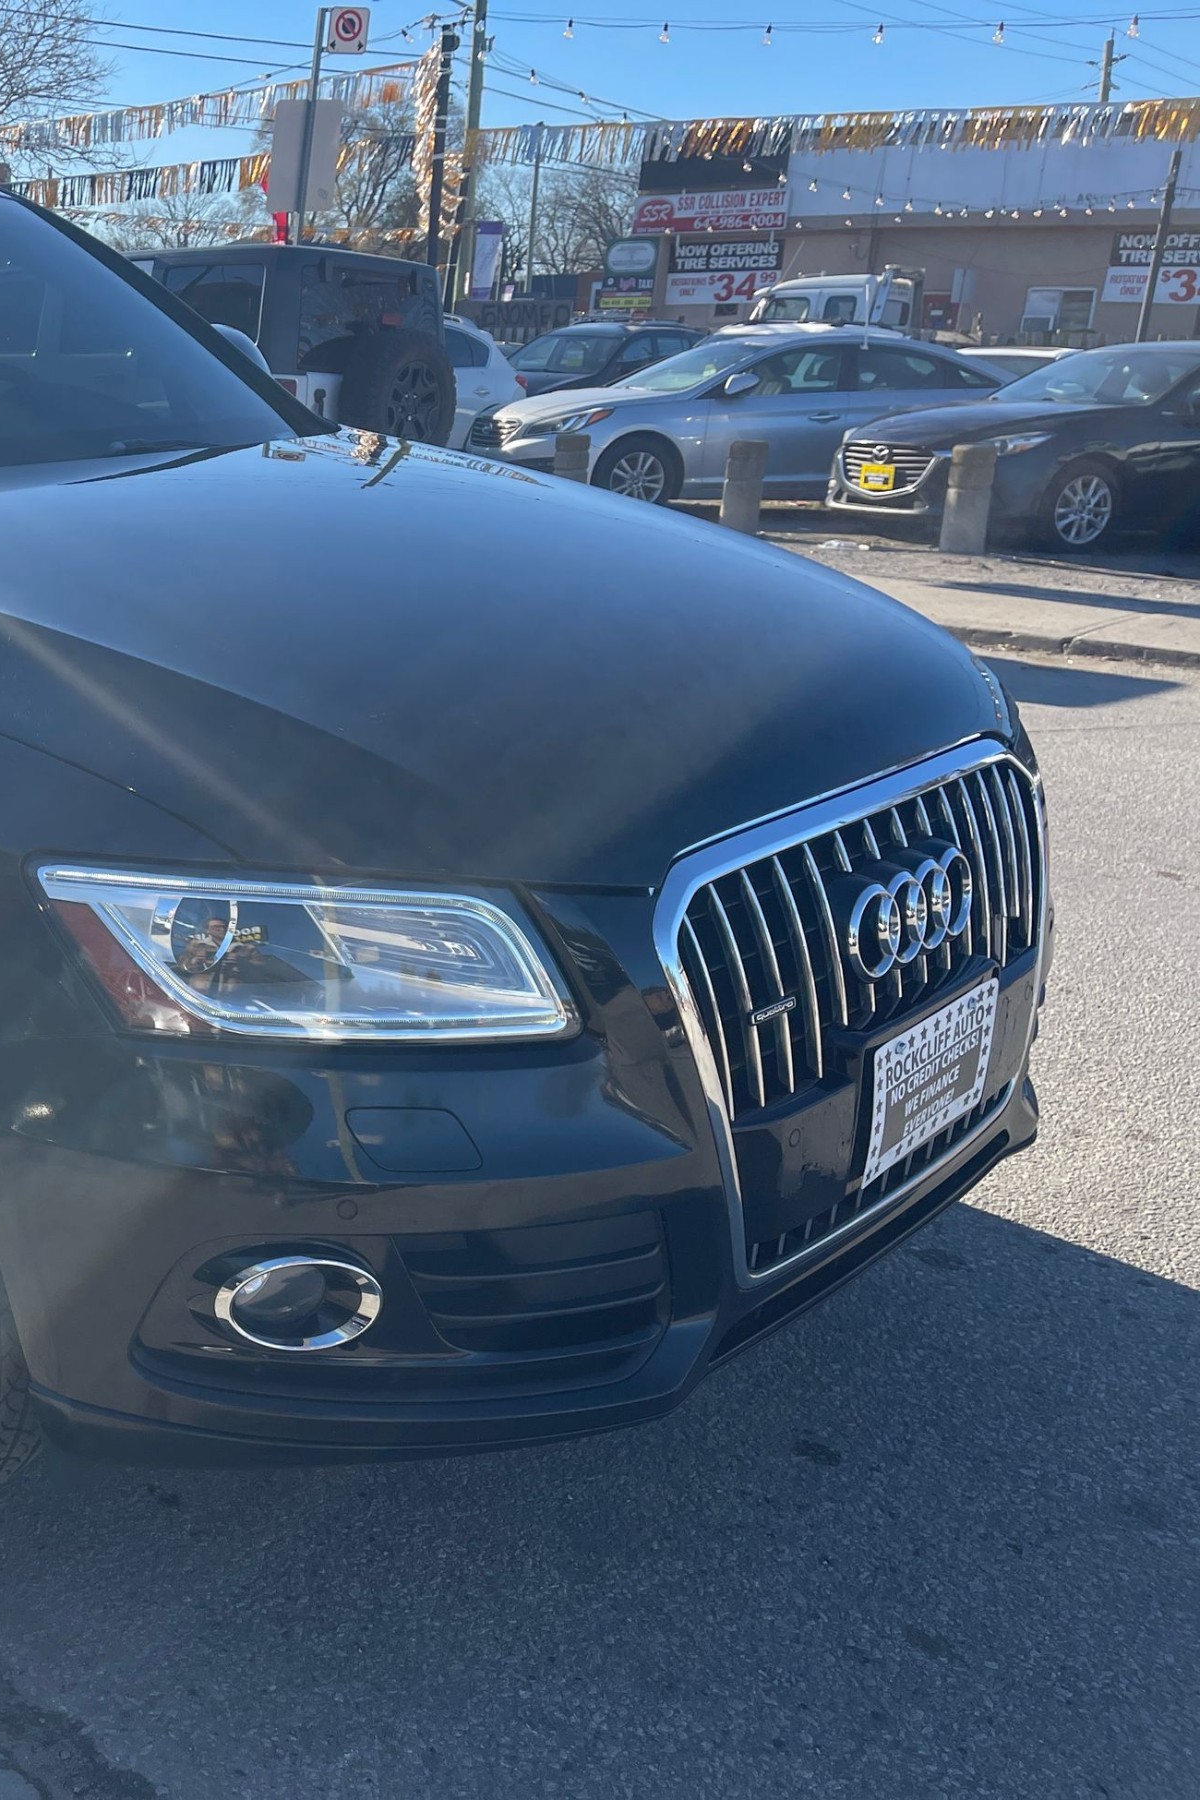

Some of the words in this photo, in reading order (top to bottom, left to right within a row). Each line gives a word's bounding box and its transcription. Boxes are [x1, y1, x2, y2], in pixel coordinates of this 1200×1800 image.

[678, 197, 695, 211] SSR
[698, 193, 746, 210] COLLISION
[749, 191, 786, 207] EXPERT
[641, 204, 672, 222] SSR
[693, 214, 784, 230] 647-986-0004
[675, 244, 708, 257] NOW
[710, 242, 779, 256] OFFERING
[1165, 233, 1200, 248] OFF
[675, 258, 707, 270] TIRE
[709, 255, 777, 269] SERVICES
[1161, 250, 1200, 264] SER
[886, 1028, 951, 1090] ROCKCLIFF
[953, 1005, 985, 1042] AUTO
[891, 1083, 906, 1107] NO
[907, 1057, 940, 1093] CREDIT
[942, 1030, 980, 1068] CHECKS!
[905, 1094, 920, 1117] WE
[920, 1064, 960, 1106] FINANCE
[903, 1088, 955, 1137] EVERYONE!
